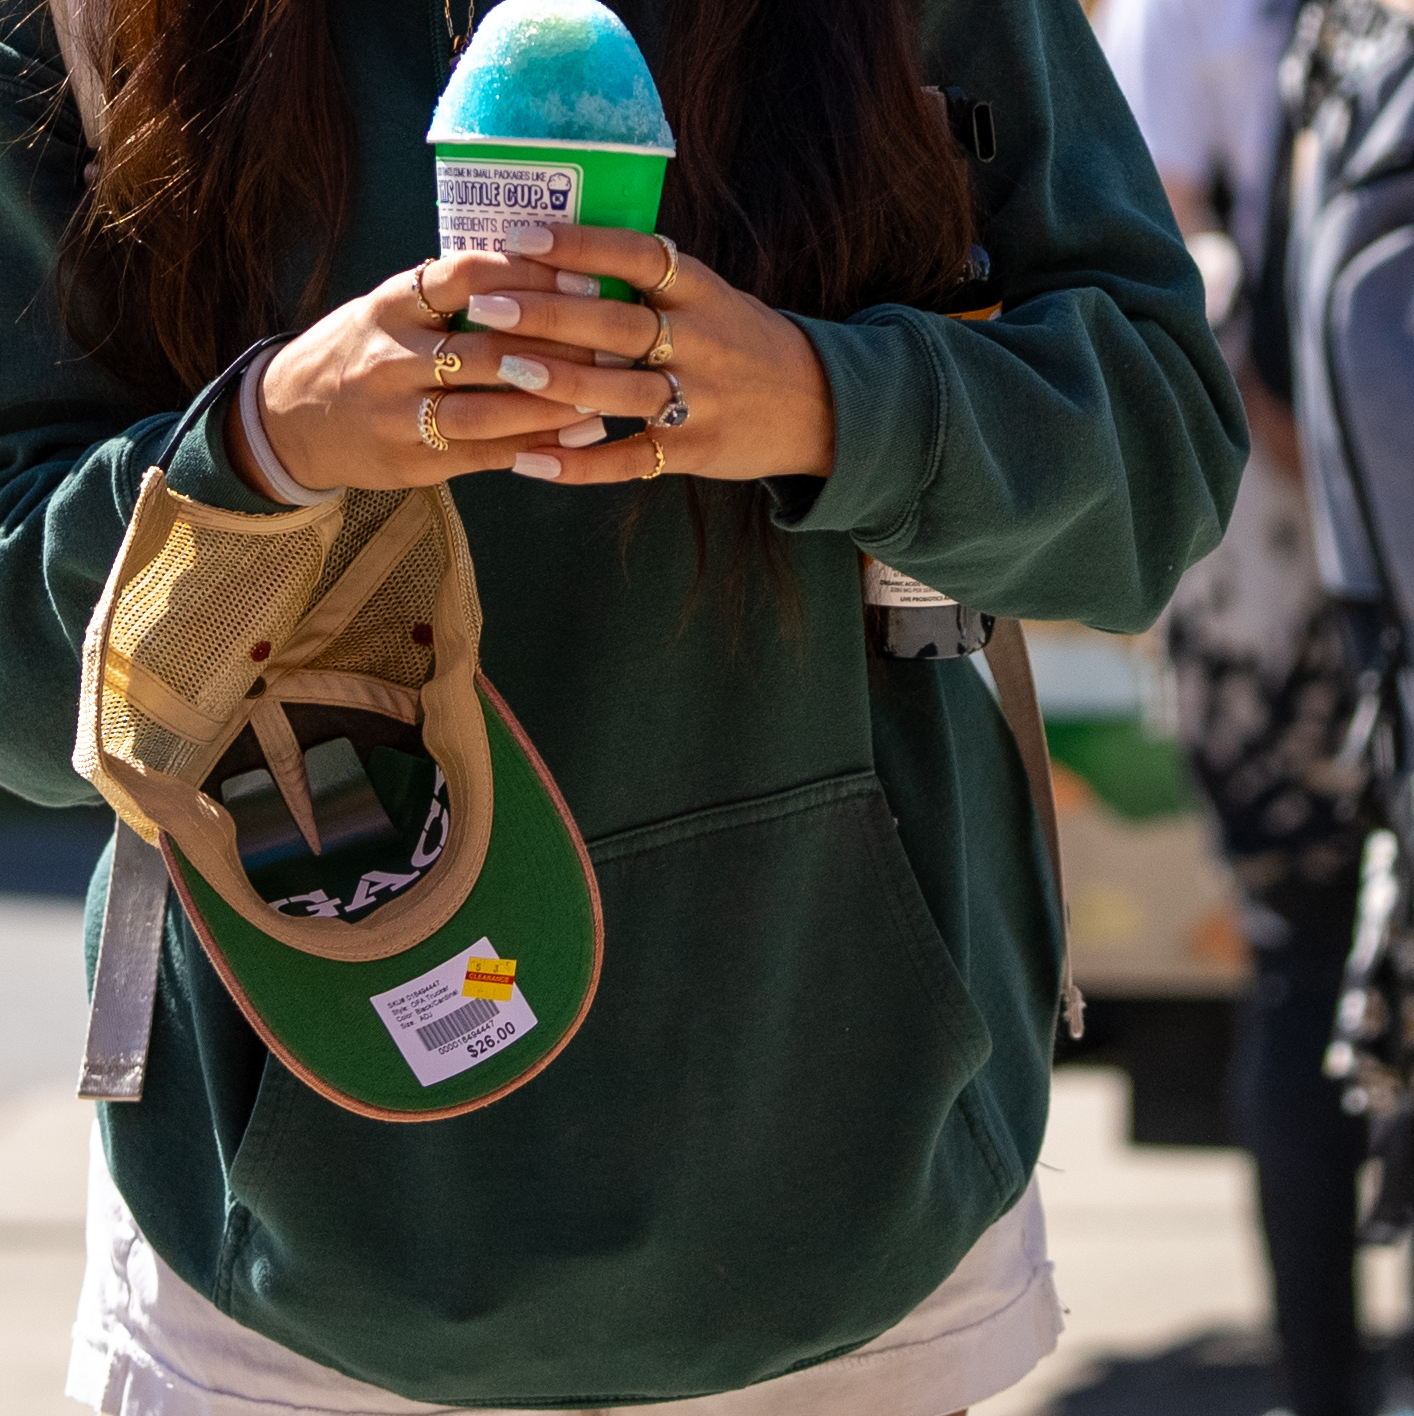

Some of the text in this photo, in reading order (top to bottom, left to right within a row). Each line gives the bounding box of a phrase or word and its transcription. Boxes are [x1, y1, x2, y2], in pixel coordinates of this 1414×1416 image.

[473, 169, 492, 179] SMALL
[494, 169, 530, 181] PACKAGES
[532, 171, 547, 182] LIKE
[455, 181, 500, 206] LITTLE
[504, 183, 548, 210] CUP.
[453, 236, 467, 250] FOR
[470, 237, 488, 251] THE
[468, 972, 510, 984] CLEARANCE
[425, 985, 448, 1000] Trucker
[419, 1011, 433, 1022] ADJ
[438, 1019, 495, 1055] 000018494447
[466, 1021, 516, 1058] $26.00
